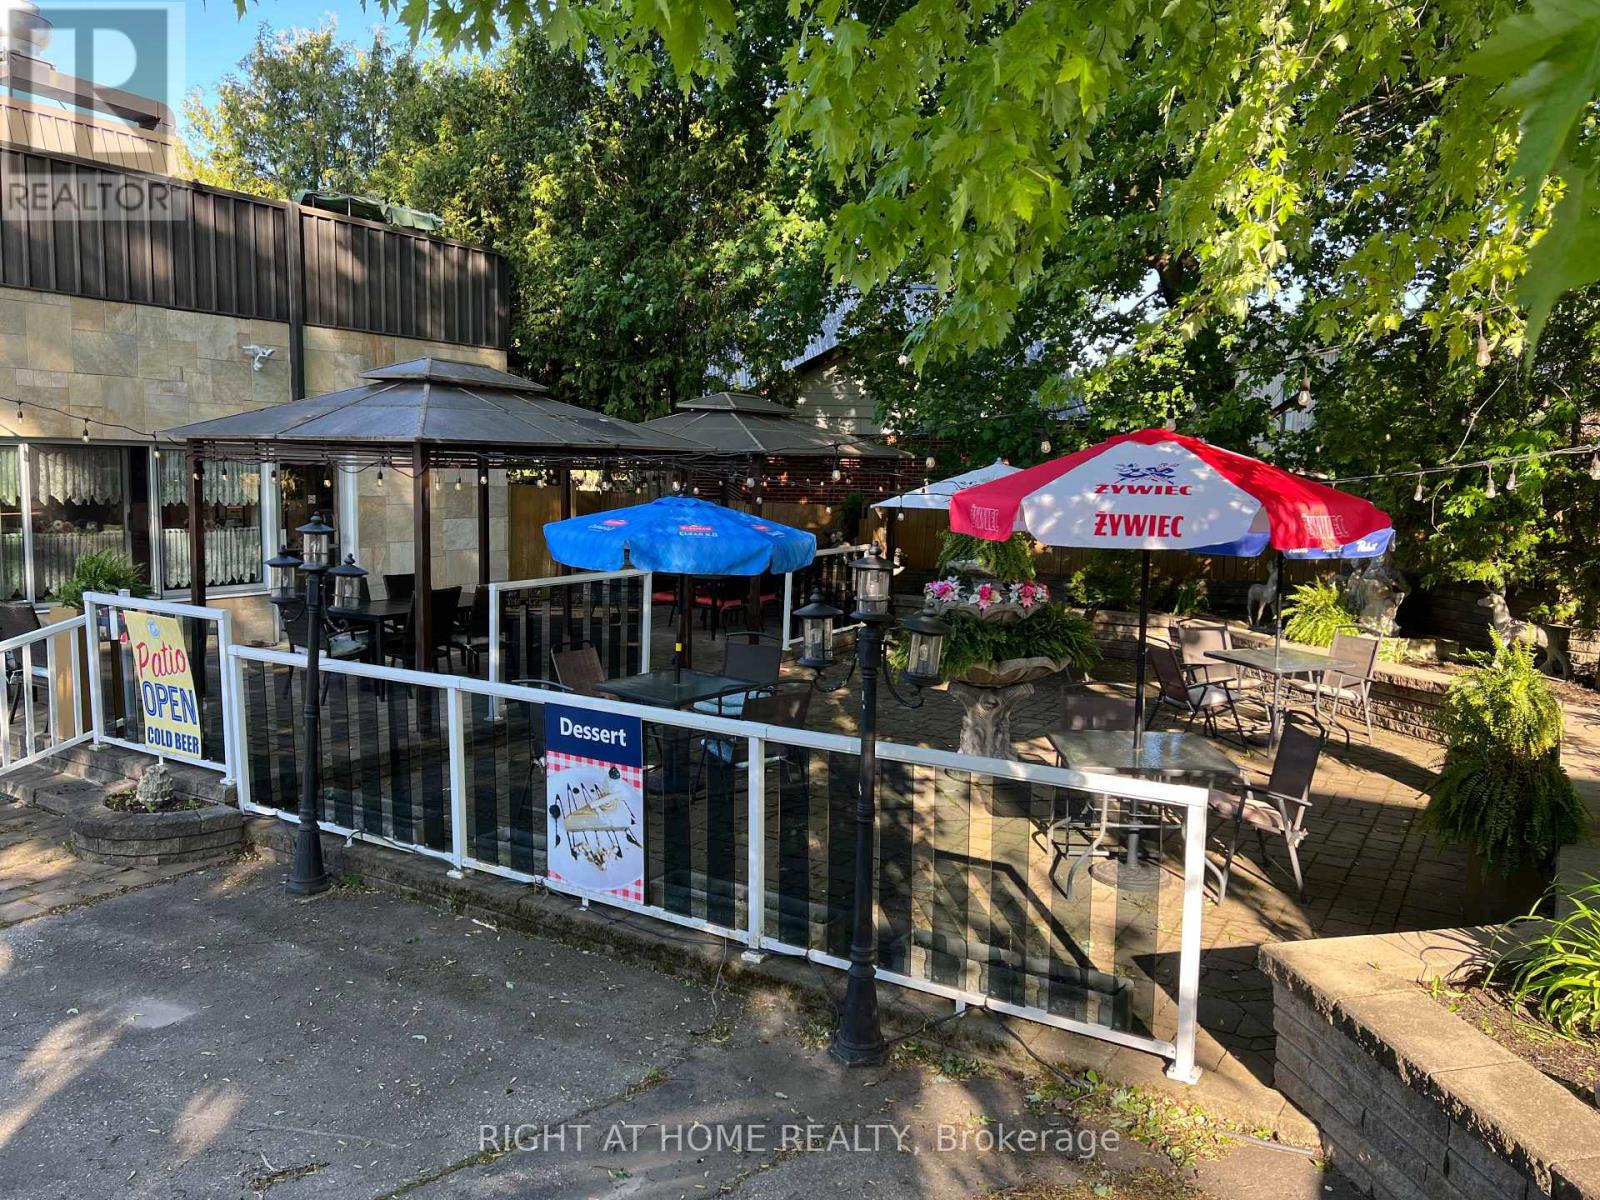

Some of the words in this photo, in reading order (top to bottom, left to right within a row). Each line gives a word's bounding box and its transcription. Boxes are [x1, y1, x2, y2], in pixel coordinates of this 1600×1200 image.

[135, 640, 187, 680] Patio
[142, 680, 198, 726] OPEN
[147, 726, 173, 748] COLD
[175, 731, 200, 755] BEER
[559, 716, 627, 747] Dessert
